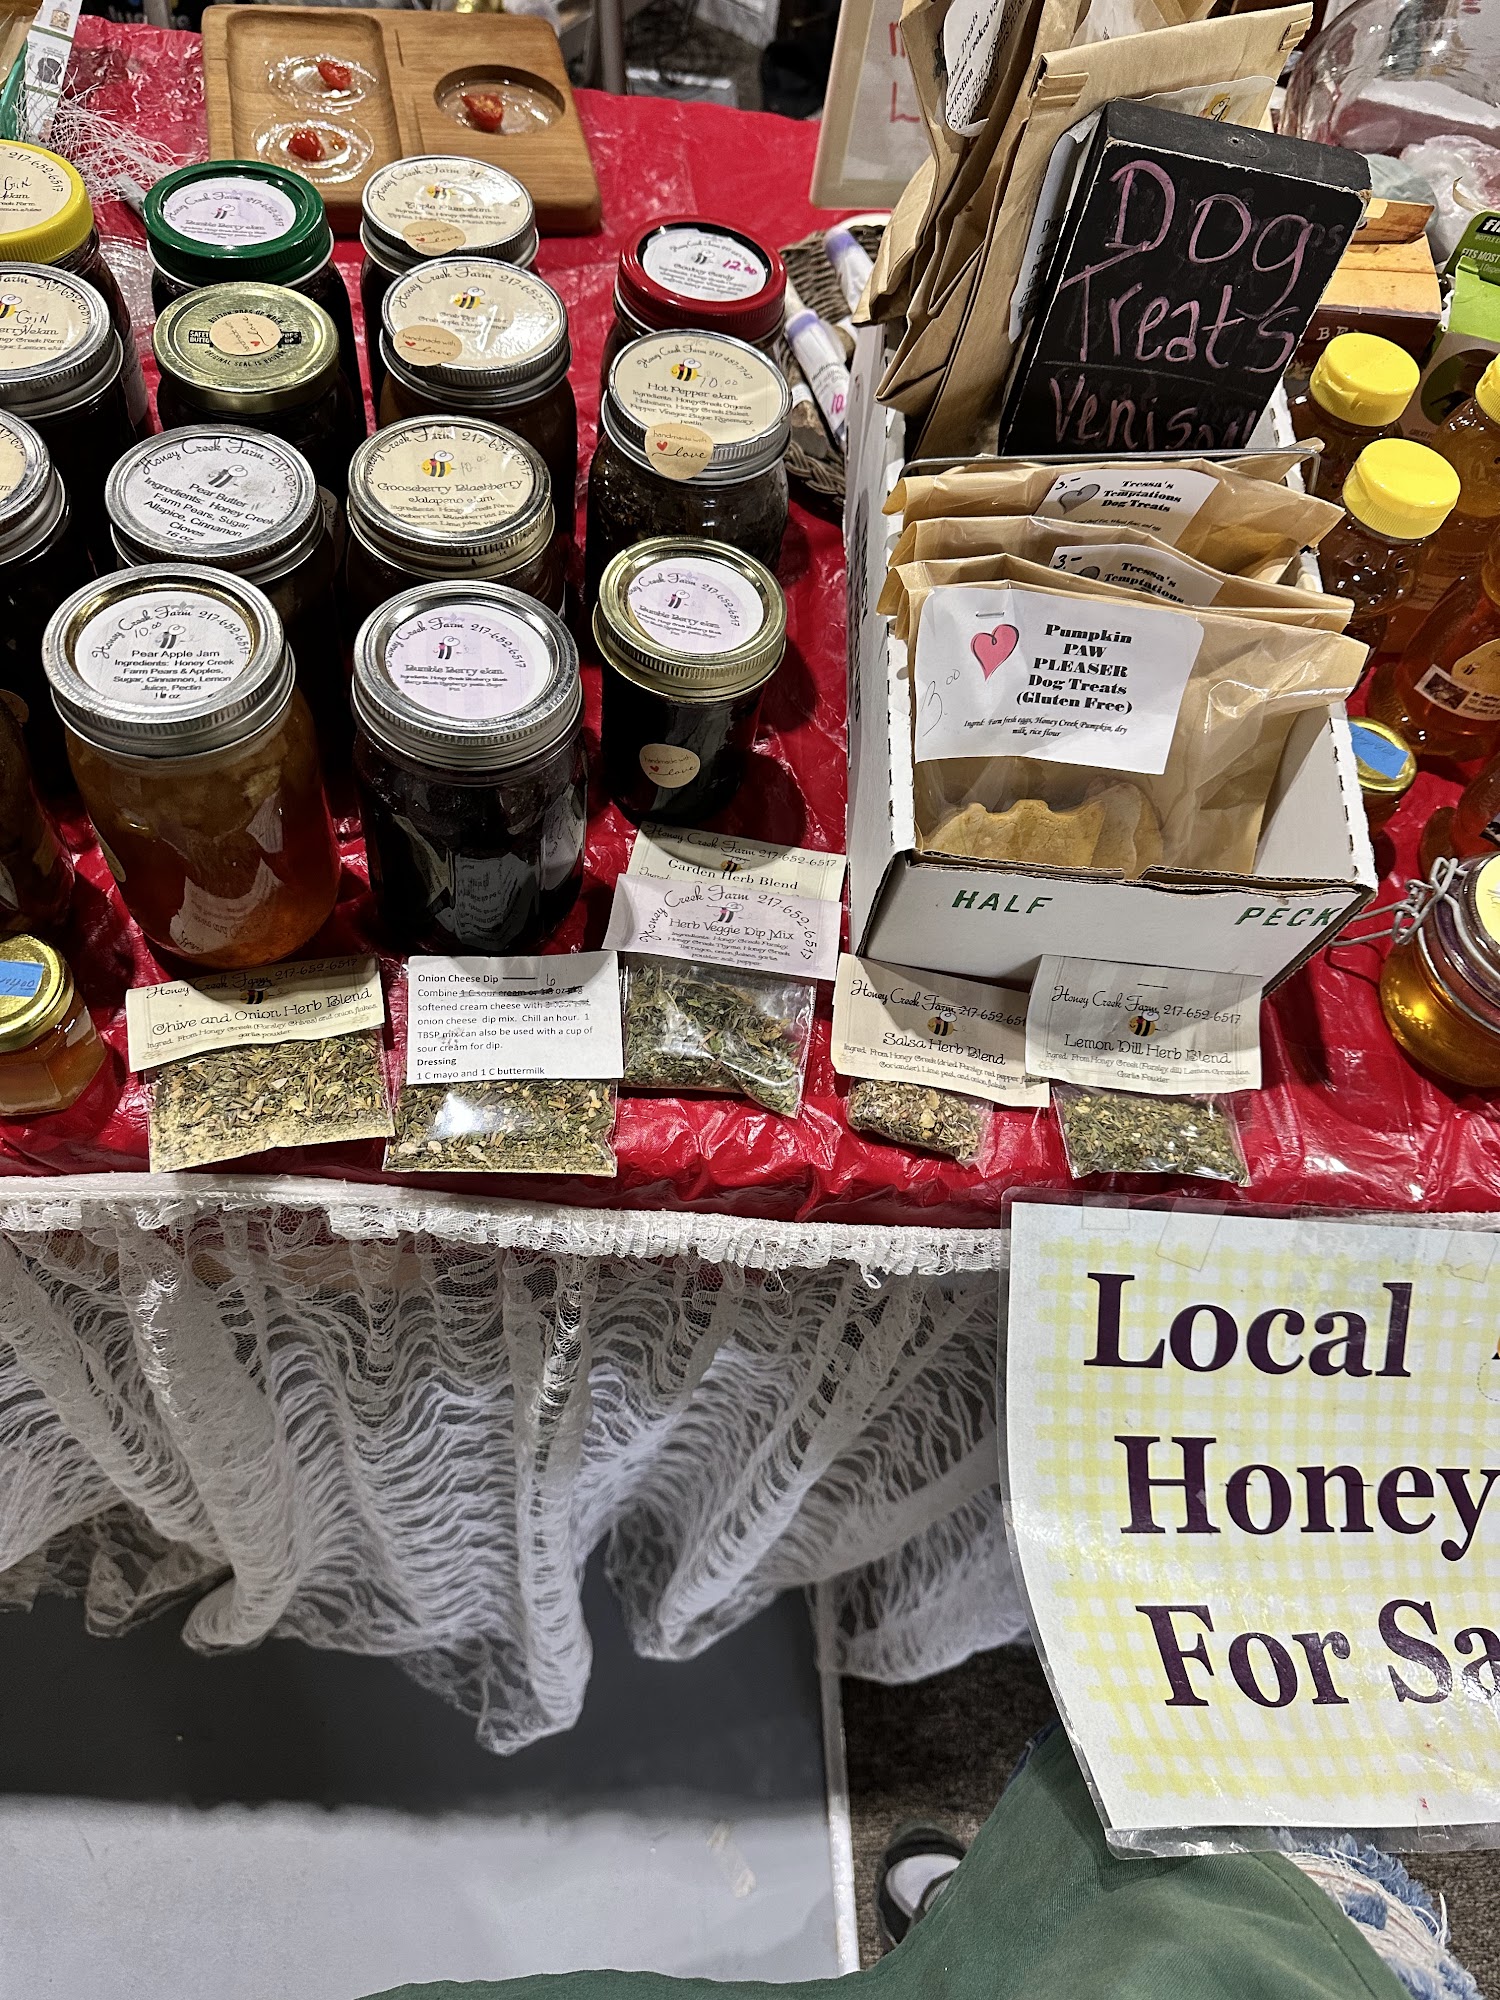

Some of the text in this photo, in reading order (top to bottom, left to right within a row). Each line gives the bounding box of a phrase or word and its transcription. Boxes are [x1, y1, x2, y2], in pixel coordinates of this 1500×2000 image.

[1105, 159, 1314, 321] Dog
[1056, 243, 1300, 374] Treats
[647, 382, 668, 391] Hot
[670, 385, 710, 398] Pepper
[134, 438, 264, 475] Honey Creek Farm
[189, 483, 249, 508] Pear Butter
[377, 480, 523, 494] Gooseberry Blackberry
[1121, 480, 1175, 490] Tressa's
[144, 477, 276, 526] Ingredients: Honey Creek
[1101, 499, 1171, 513] Dog Treats
[1103, 490, 1182, 503] Temptations
[144, 500, 244, 539] Allspice, Cinnamon,
[153, 492, 251, 530] Farm Pears, Sugar,
[169, 521, 205, 538] Cloves
[1121, 562, 1176, 588] Tressa's
[1104, 573, 1185, 604] Temptations
[92, 605, 252, 660] Honey Creek Farm 217-652-6517
[431, 617, 464, 631] Farm
[470, 623, 527, 669] 217-652-6517
[1044, 624, 1132, 645] Pumpkin
[131, 650, 220, 659] Pear Apple Jam
[1062, 643, 1108, 658] PAW
[114, 659, 170, 667] Ingredients:
[174, 659, 205, 667] Honey
[189, 667, 224, 676] Apples,
[404, 665, 443, 674] Bumble
[445, 665, 478, 677] Berry
[1033, 658, 1128, 678] PLEASER
[113, 675, 232, 683] Sugar, Cinnamon, Lemon
[140, 683, 202, 692] Juice, Pectin
[1028, 674, 1127, 696] Dog Treats
[1016, 690, 1133, 715] (Gluten Free)
[1003, 716, 1017, 726] fresh
[1018, 717, 1033, 726] eggs,
[1035, 717, 1057, 727] Honey
[1059, 719, 1079, 729] Creek
[1080, 721, 1113, 732] Pumpkin,
[1114, 725, 1128, 735] dry
[644, 824, 837, 867] Honey Creek Farm 217-652-6517
[668, 859, 716, 879] Garden
[720, 871, 754, 885] Herb
[758, 876, 799, 890] Blend
[950, 890, 1344, 927] HALF PECK
[639, 884, 818, 961] Honey Creek Farm 217-652-6517
[669, 918, 794, 941] Herb Veggie Dip Mix
[418, 974, 445, 982] Onion
[483, 975, 499, 984] Dip
[418, 989, 458, 997] Combine
[152, 987, 373, 1035] Chive and Onion Herb Blend
[418, 1003, 457, 1011] softened
[490, 1002, 520, 1010] cheese
[1051, 985, 1241, 1025] Honey Creek Farm 217-652-6517
[446, 1017, 477, 1025] cheese
[482, 1016, 496, 1024] dip
[443, 1030, 459, 1038] mix
[584, 1026, 593, 1034] of
[440, 1044, 467, 1052] cream
[486, 1042, 503, 1050] dip.
[882, 1032, 1006, 1066] Salsa Herb Blend
[1064, 1033, 1232, 1064] Lemon Dill Herb Blend
[417, 1058, 457, 1066] Dressing
[461, 1069, 478, 1077] and
[498, 1067, 545, 1075] buttermilk
[1083, 1270, 1413, 1379] Local
[1113, 1435, 1500, 1562] Honey
[1135, 1598, 1500, 1709] For Sa
